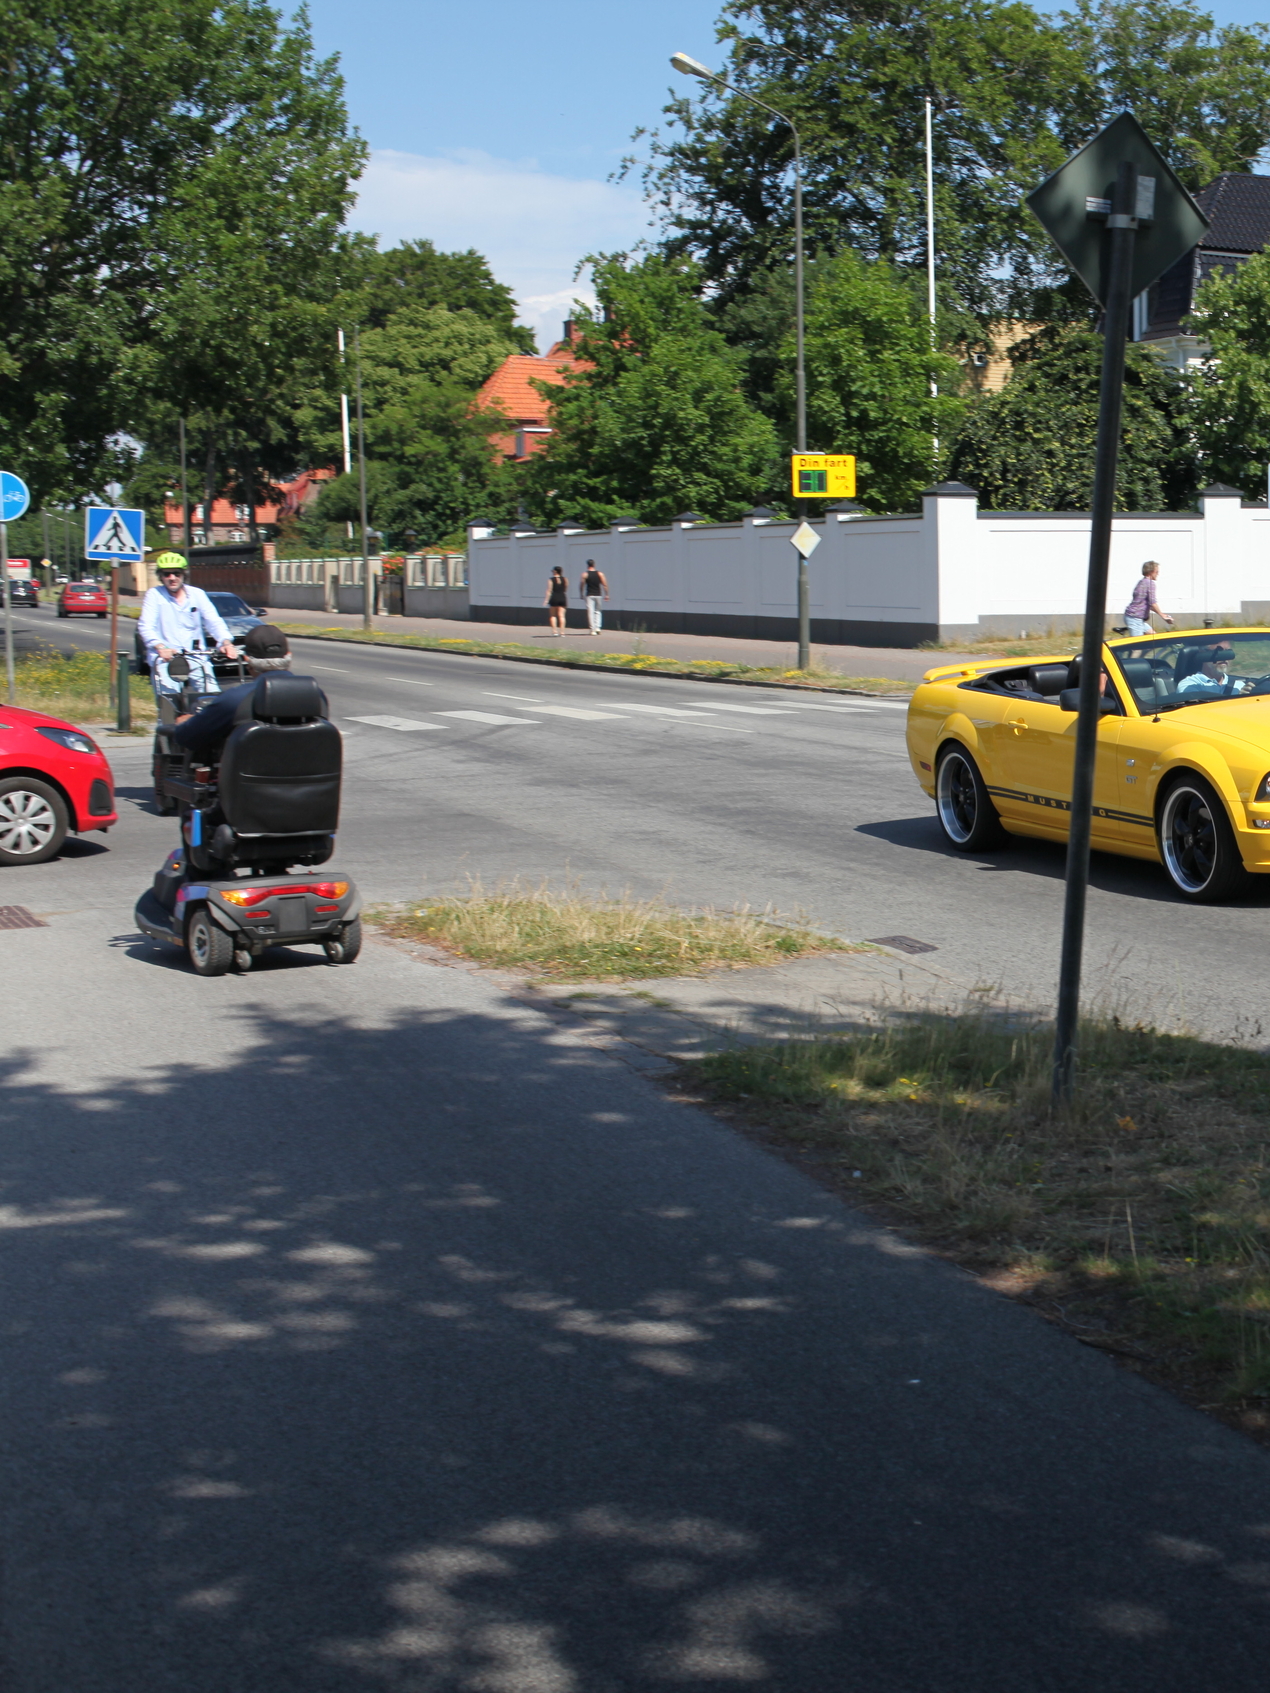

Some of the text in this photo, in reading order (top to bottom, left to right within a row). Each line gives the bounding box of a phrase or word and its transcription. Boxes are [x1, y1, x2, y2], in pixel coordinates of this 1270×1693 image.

[800, 458, 848, 467] Din fart
[800, 470, 827, 492] 30
[1027, 795, 1107, 816] MUSTG
